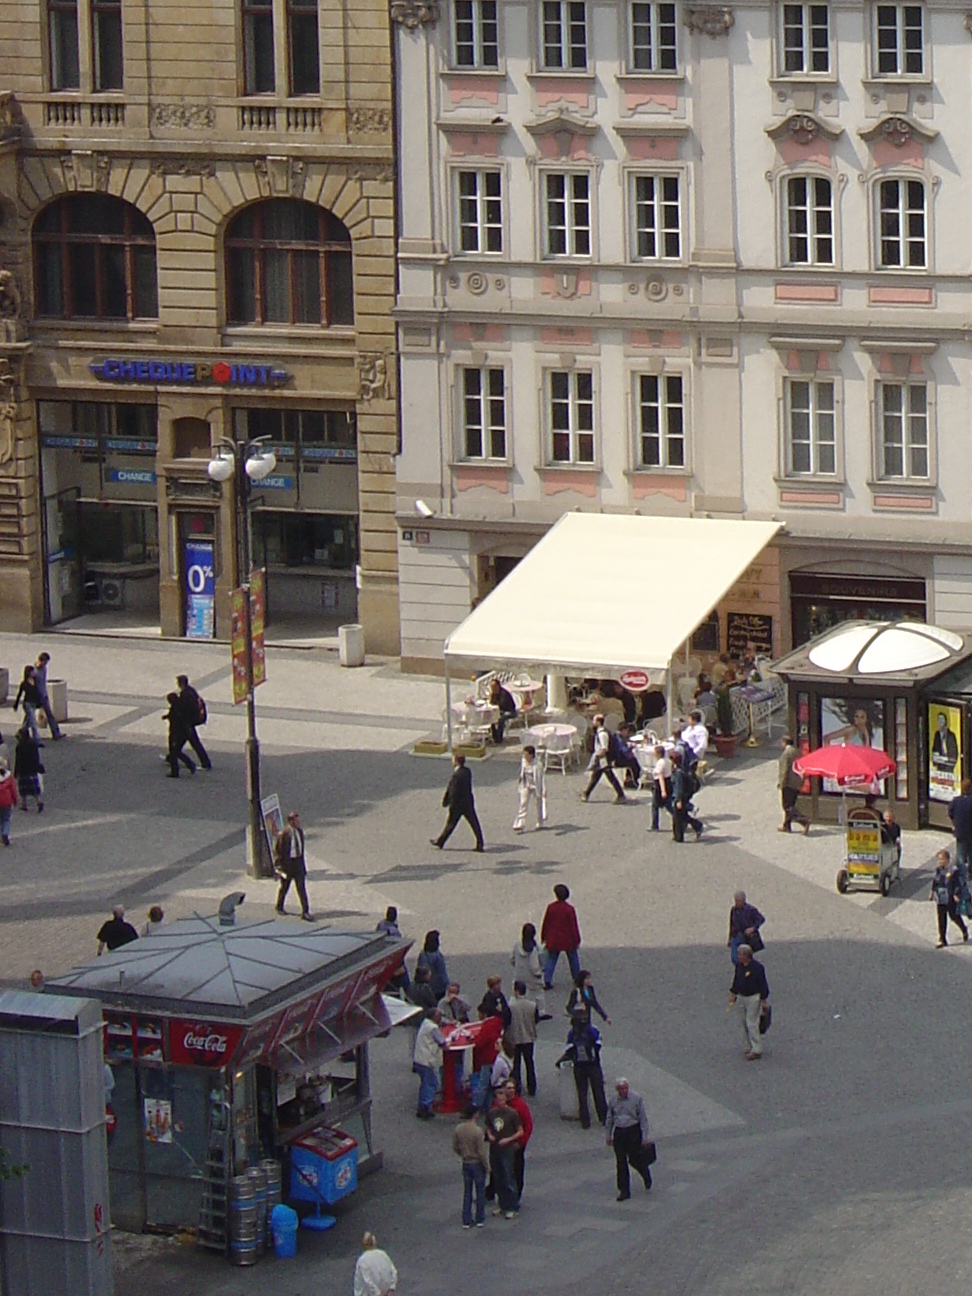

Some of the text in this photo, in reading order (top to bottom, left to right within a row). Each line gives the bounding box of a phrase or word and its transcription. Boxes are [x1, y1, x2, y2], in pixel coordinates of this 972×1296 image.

[103, 357, 272, 385] CHEQUEPOINT
[117, 471, 152, 482] CHANGE
[188, 564, 214, 593] 0%
[821, 584, 898, 597] SOUVENIRS
[183, 1030, 229, 1053] Coca-Cola
